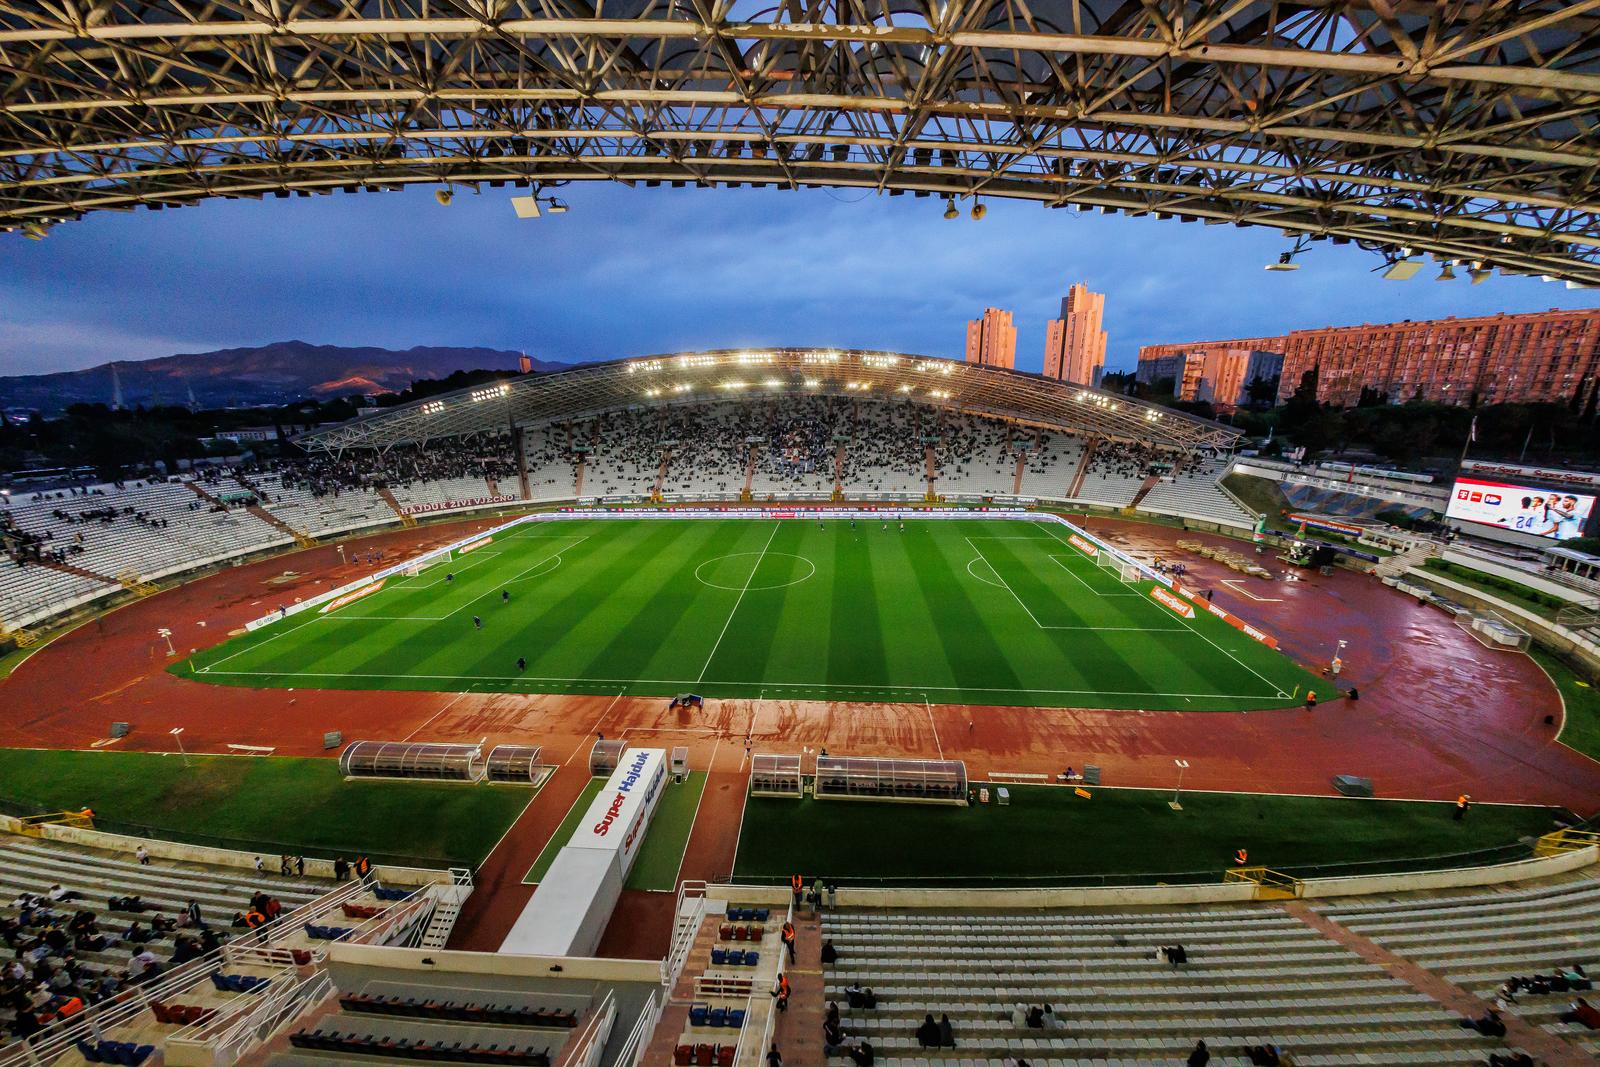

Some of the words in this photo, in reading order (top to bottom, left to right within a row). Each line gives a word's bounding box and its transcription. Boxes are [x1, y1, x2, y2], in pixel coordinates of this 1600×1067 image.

[400, 503, 447, 515] HAJDUK
[1516, 516, 1533, 528] 24
[594, 792, 626, 836] Super
[618, 752, 650, 792] Hajduk
